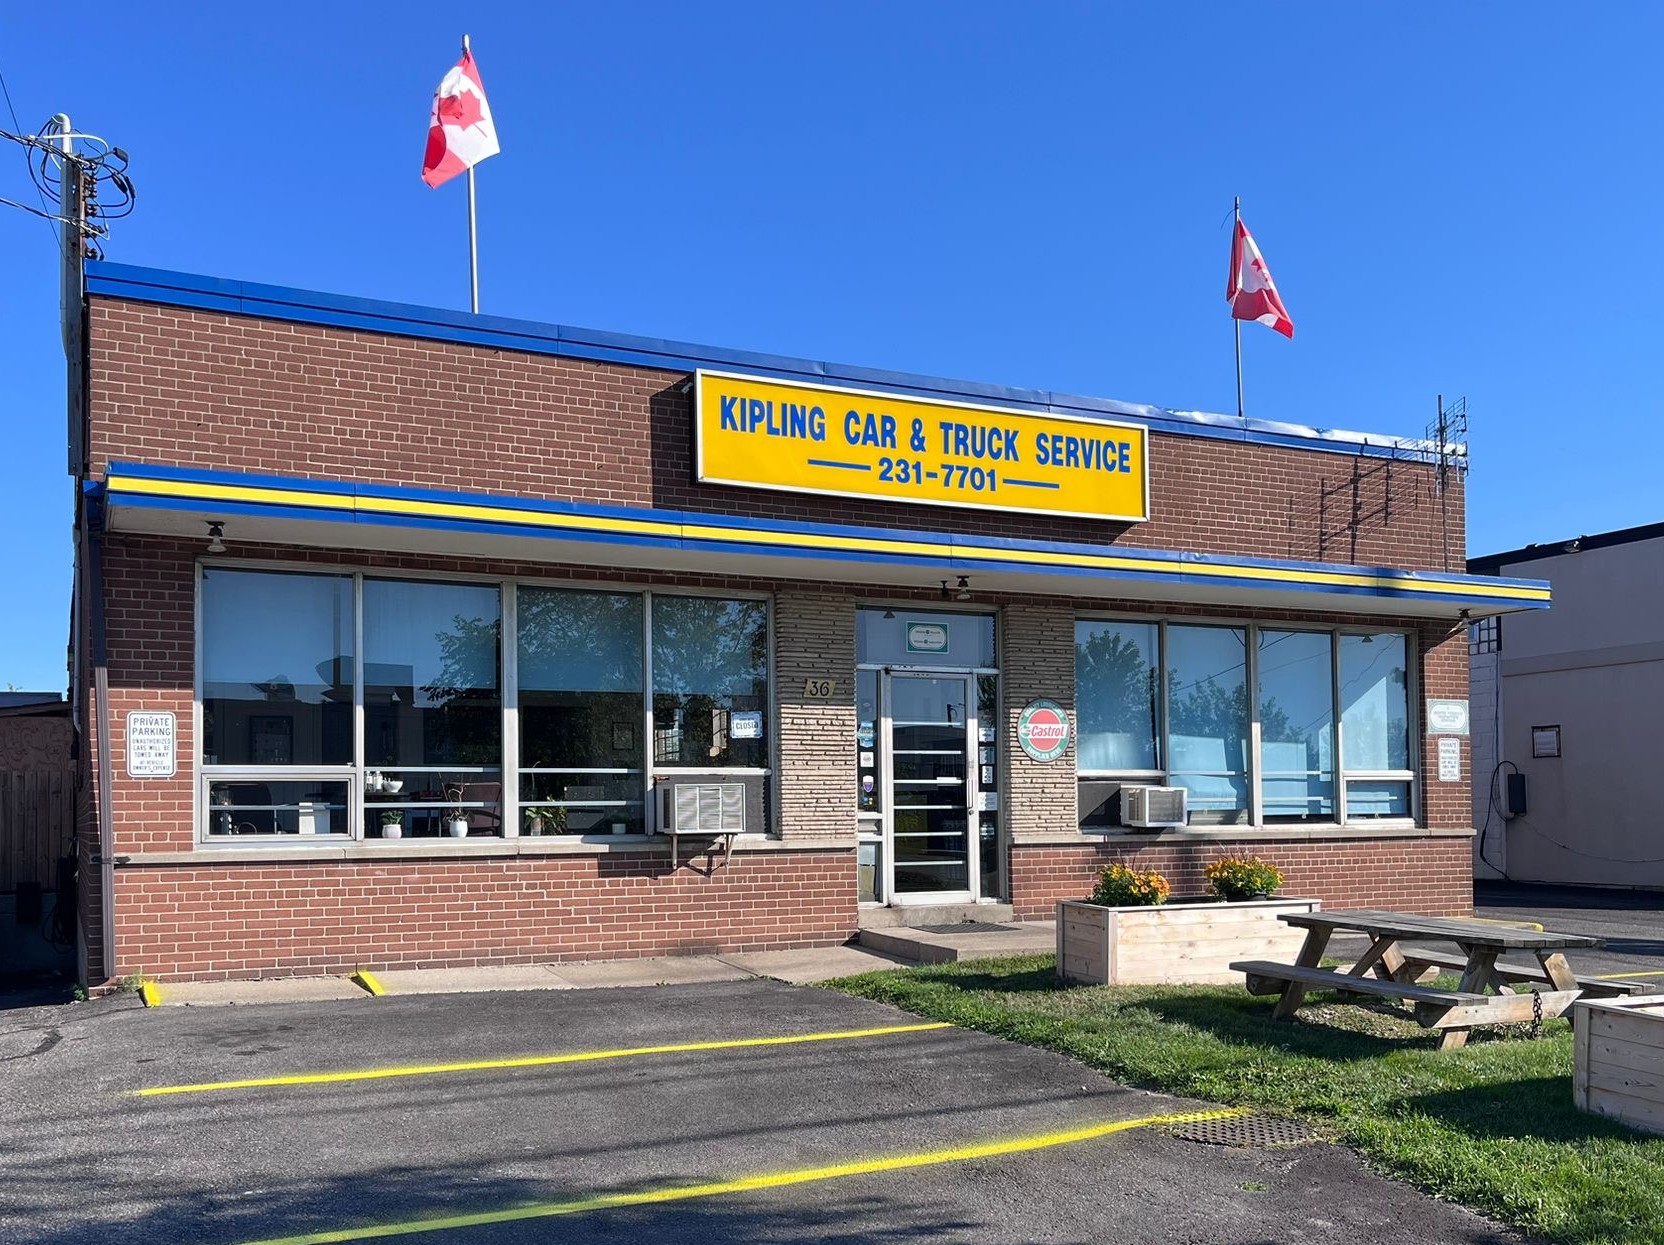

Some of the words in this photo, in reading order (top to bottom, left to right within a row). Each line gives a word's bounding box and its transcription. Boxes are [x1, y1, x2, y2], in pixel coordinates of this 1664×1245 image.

[720, 395, 826, 442] KIPLING
[844, 410, 896, 449] CAR
[910, 418, 926, 452] &
[940, 422, 1020, 462] TRUCK
[1036, 432, 1131, 473] SERVICE
[878, 457, 997, 492] 231-7701
[809, 681, 829, 696] 36
[133, 717, 170, 726] PRIVATE
[132, 727, 171, 736] PARKING
[1031, 725, 1065, 737] Castrol
